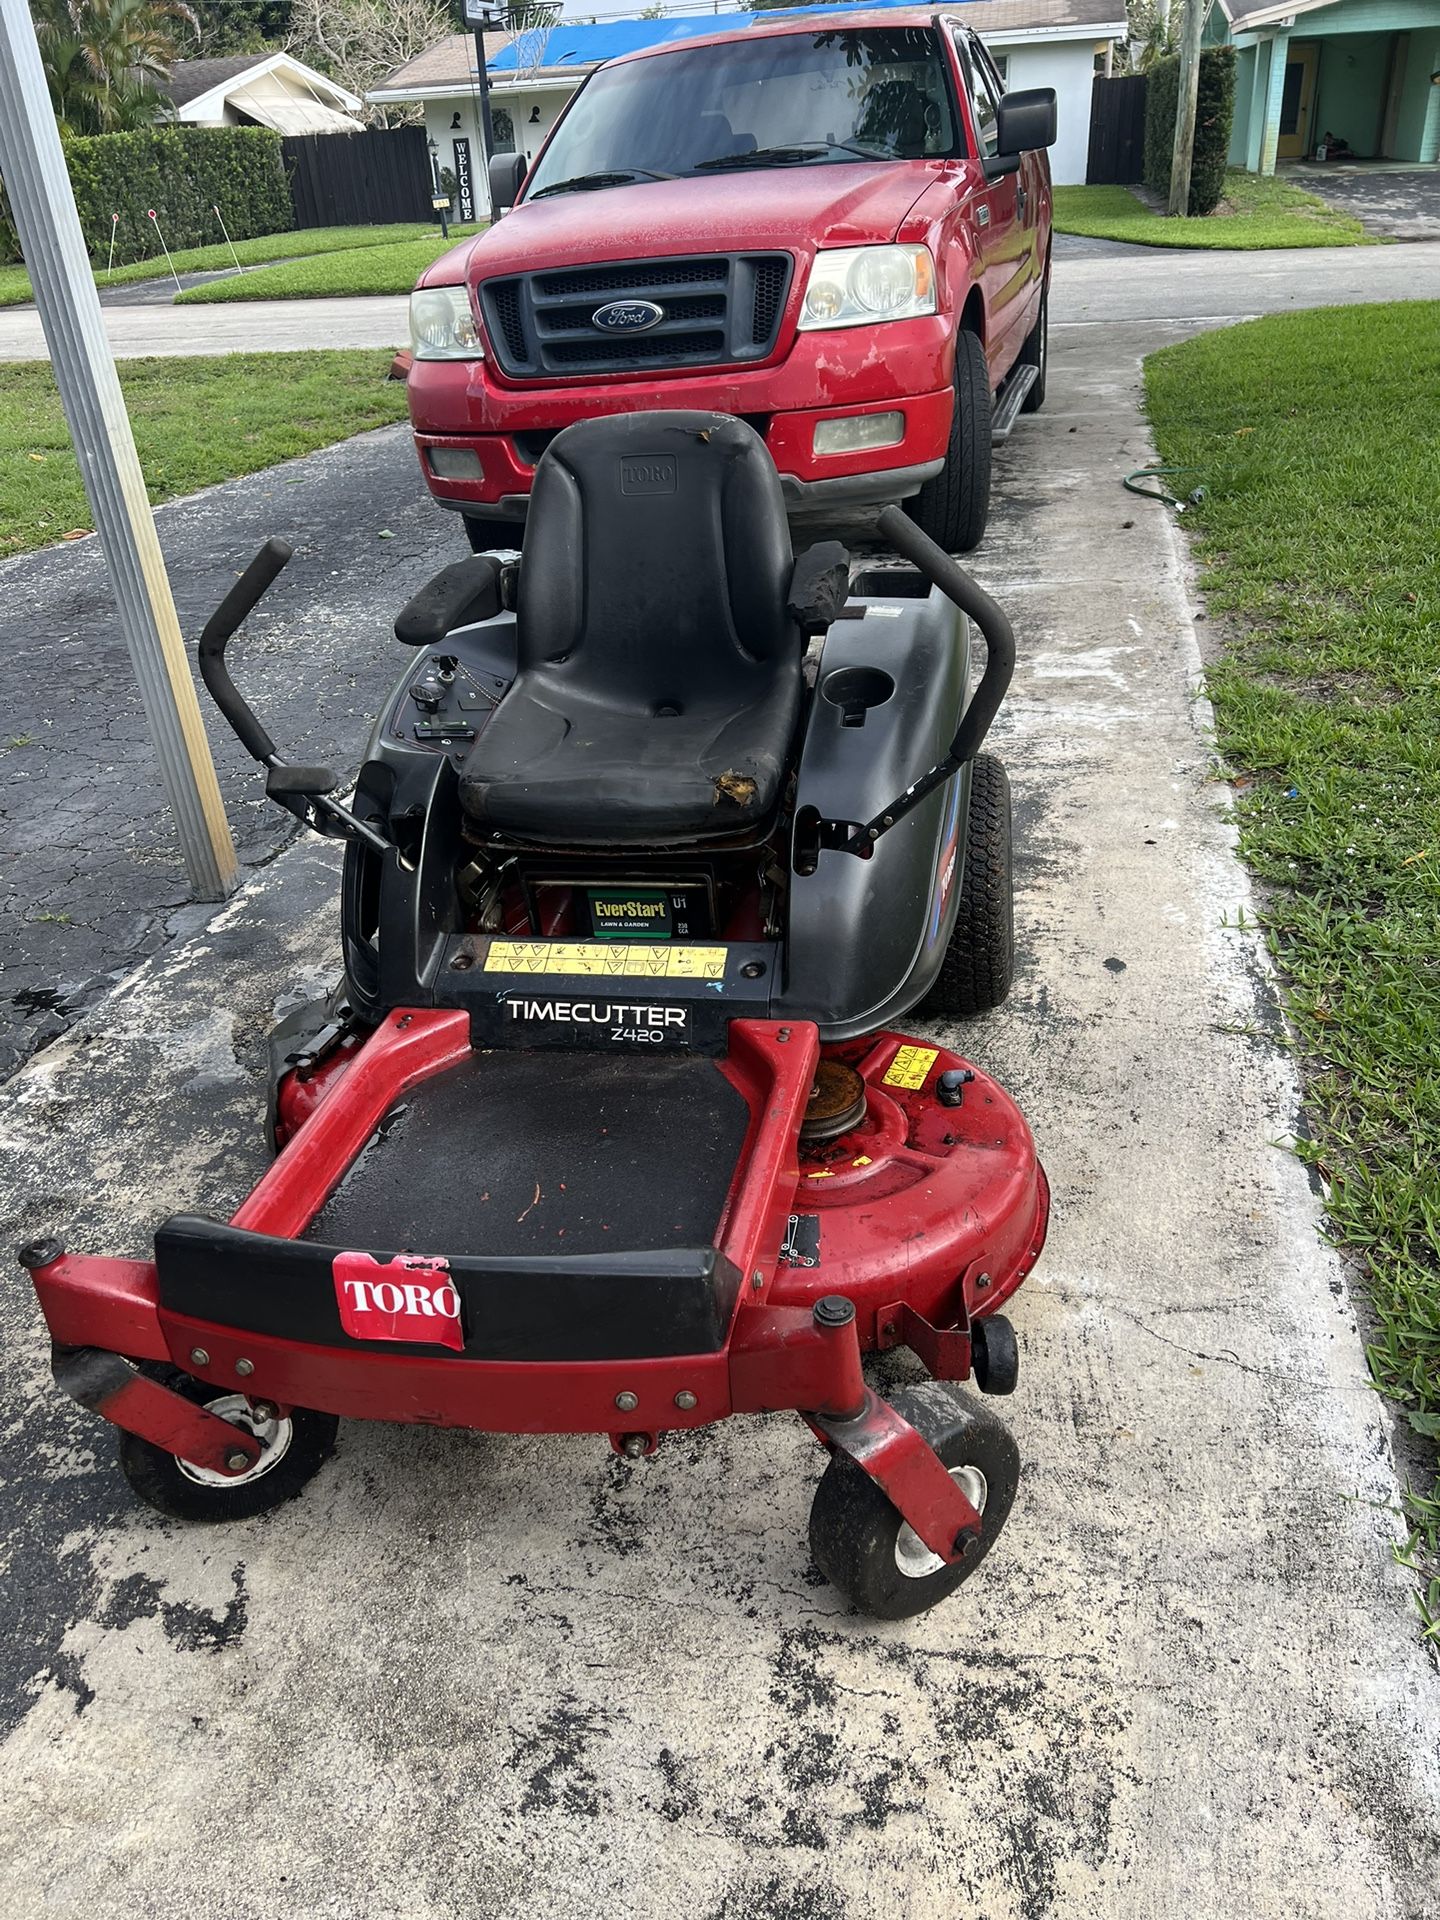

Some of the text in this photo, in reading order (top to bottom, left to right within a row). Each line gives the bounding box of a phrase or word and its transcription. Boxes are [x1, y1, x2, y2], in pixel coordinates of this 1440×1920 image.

[456, 142, 472, 220] WELCOME
[608, 306, 646, 325] Ford
[623, 465, 673, 483] TORO
[595, 901, 666, 917] EverStart
[673, 898, 686, 909] U1
[507, 1000, 687, 1027] TIMECUTTER
[611, 1027, 664, 1043] Z420
[344, 1280, 461, 1319] TORO
